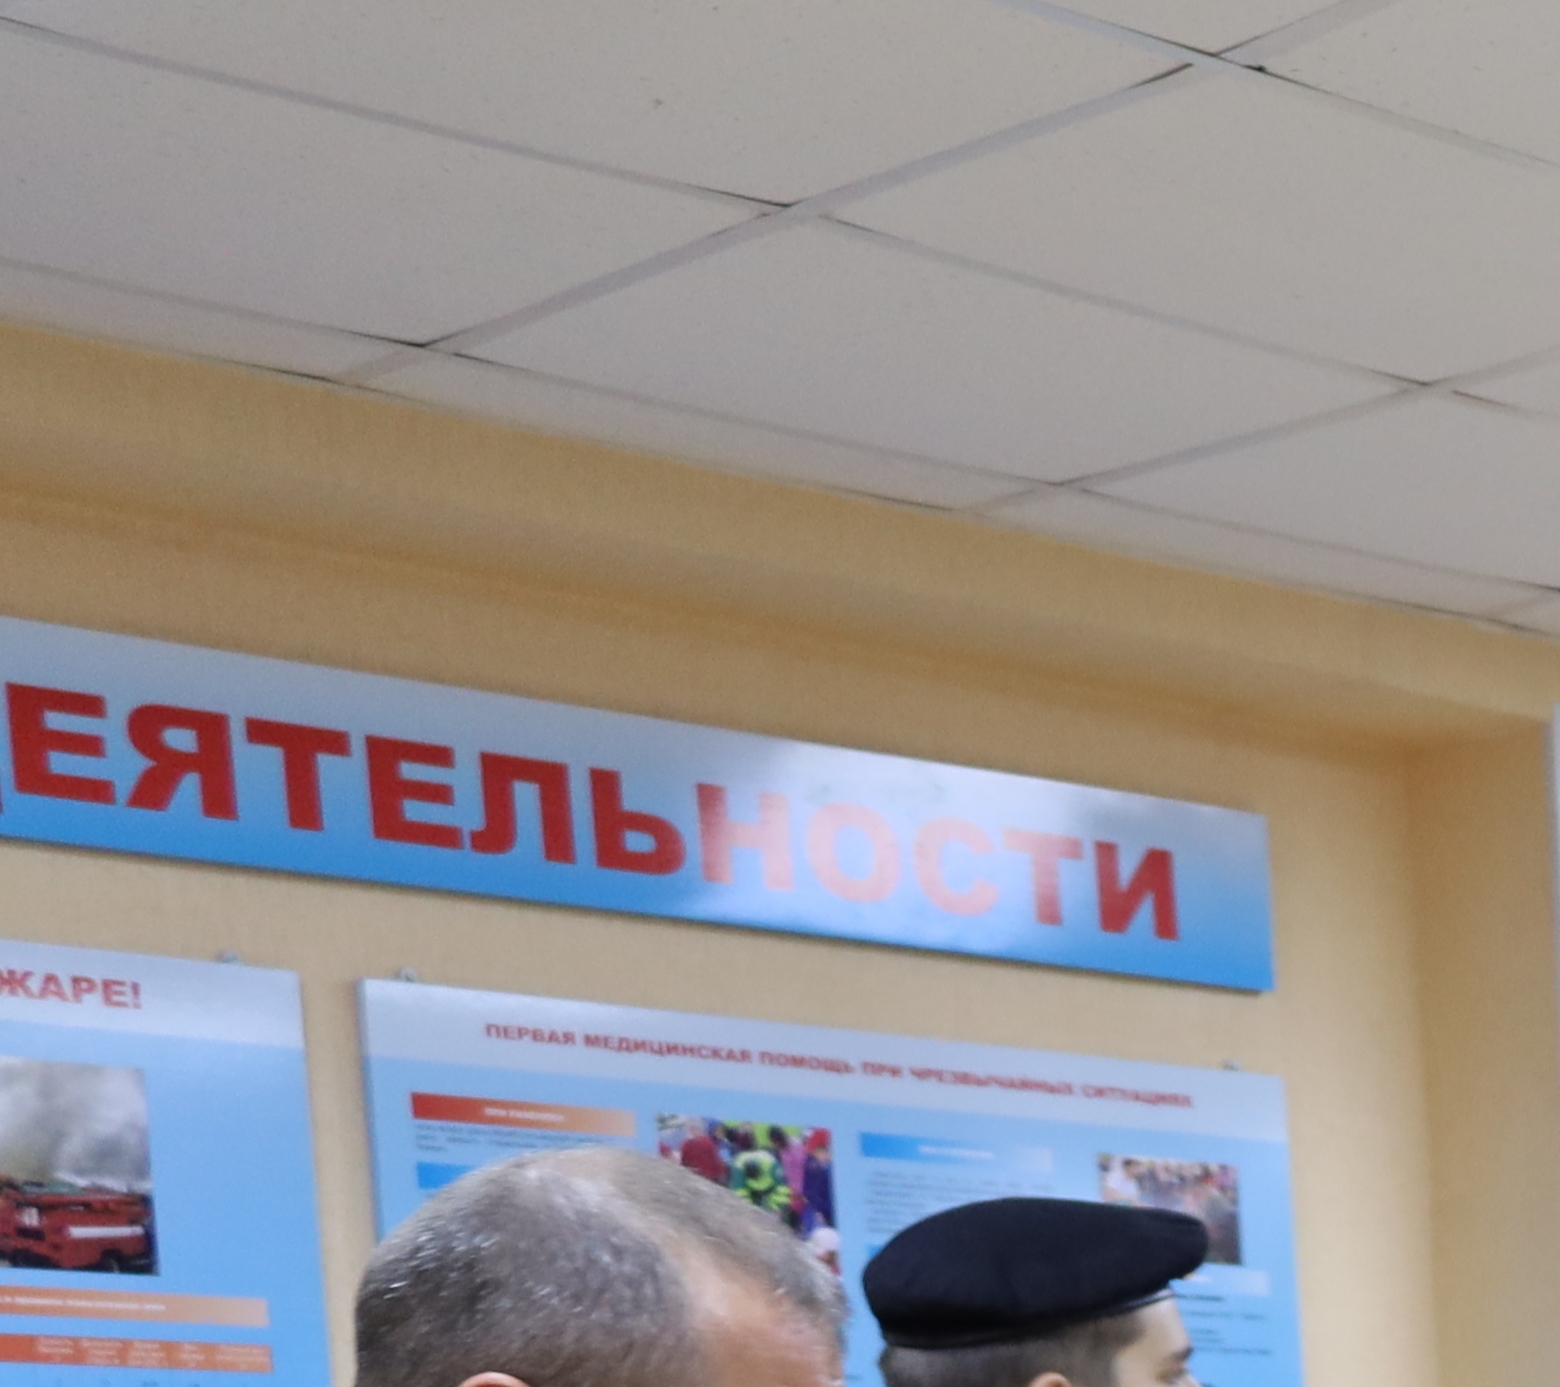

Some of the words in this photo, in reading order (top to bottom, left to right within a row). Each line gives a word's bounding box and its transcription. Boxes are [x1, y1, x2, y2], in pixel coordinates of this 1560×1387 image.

[4, 681, 1182, 941] ЕЯТЕЛЬНОСТИ
[0, 969, 141, 1009] ЖАРЕ!
[485, 1023, 576, 1046] ПЕРВАЯ
[584, 1033, 753, 1064] МЕДИЦИНСКАЯ
[759, 1050, 855, 1075] ПОМОЩЬ
[861, 1061, 903, 1078] ПРИ
[909, 1067, 1074, 1096] ЧРЕЗВЫЧАЙНЫХ
[1082, 1083, 1194, 1108] СИТУАЦИЯХ
